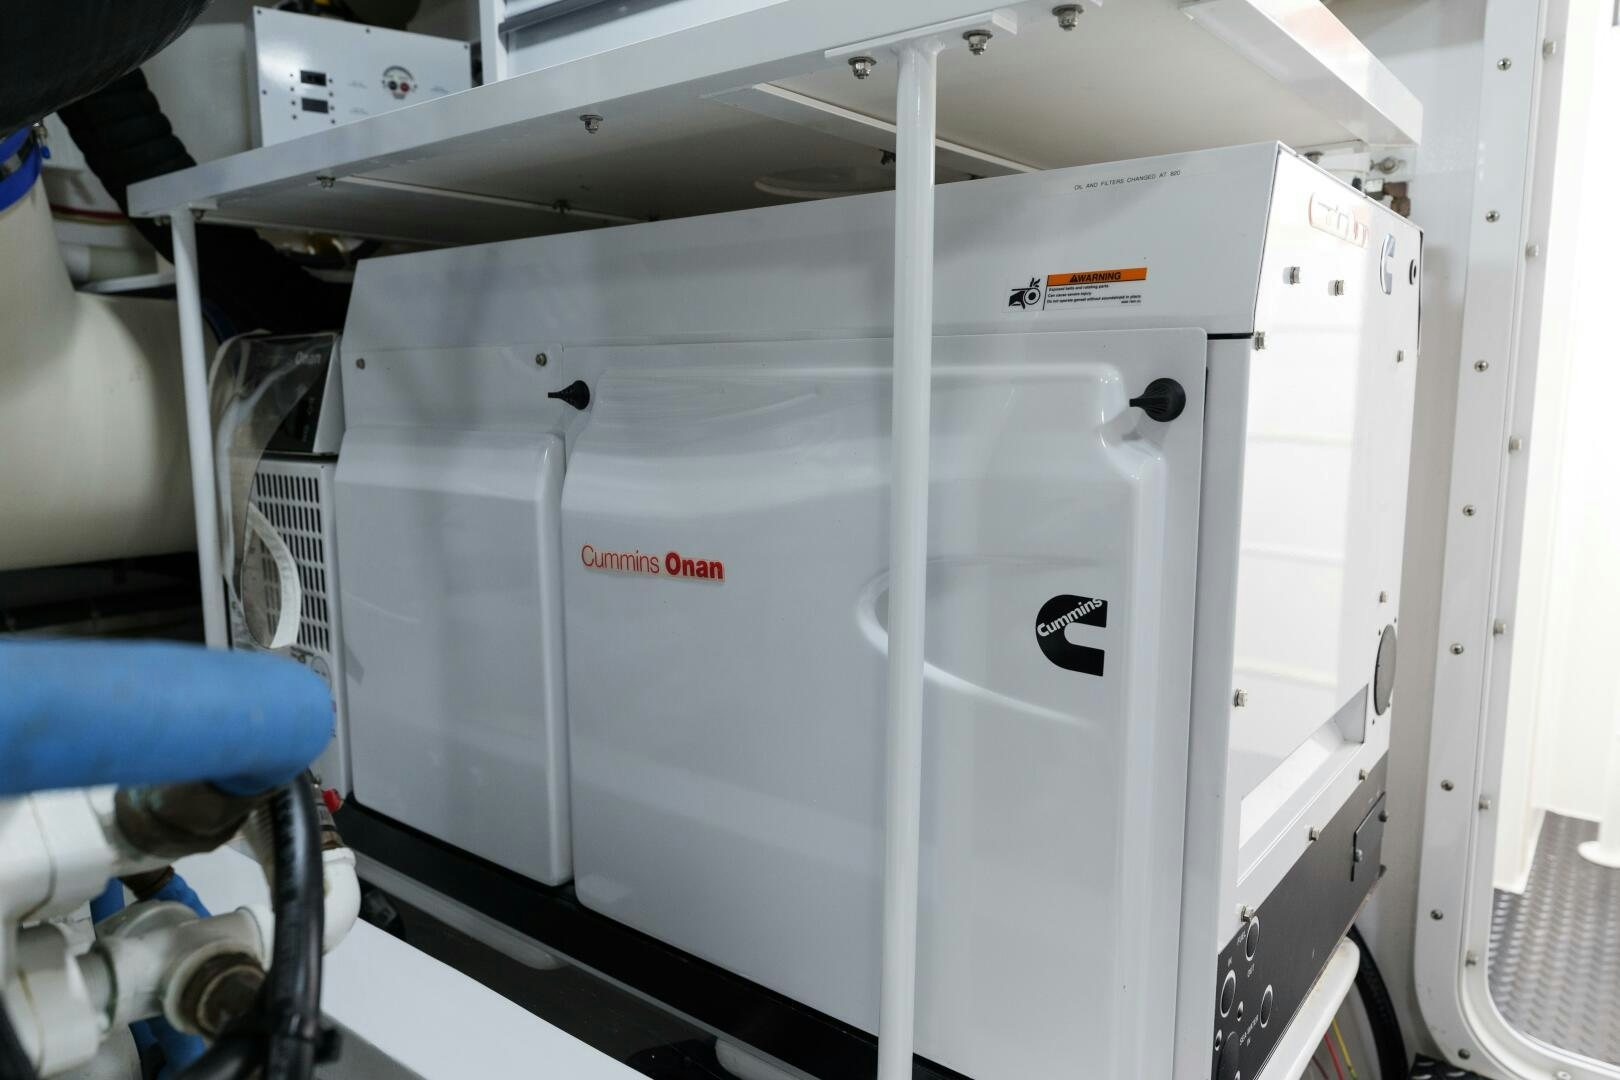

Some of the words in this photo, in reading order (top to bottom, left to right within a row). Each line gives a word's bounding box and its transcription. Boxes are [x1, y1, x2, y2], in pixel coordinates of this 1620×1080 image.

[1078, 271, 1121, 283] WARNING
[581, 544, 661, 575] Cummins
[665, 551, 725, 580] Onan
[1037, 597, 1103, 637] Cummins
